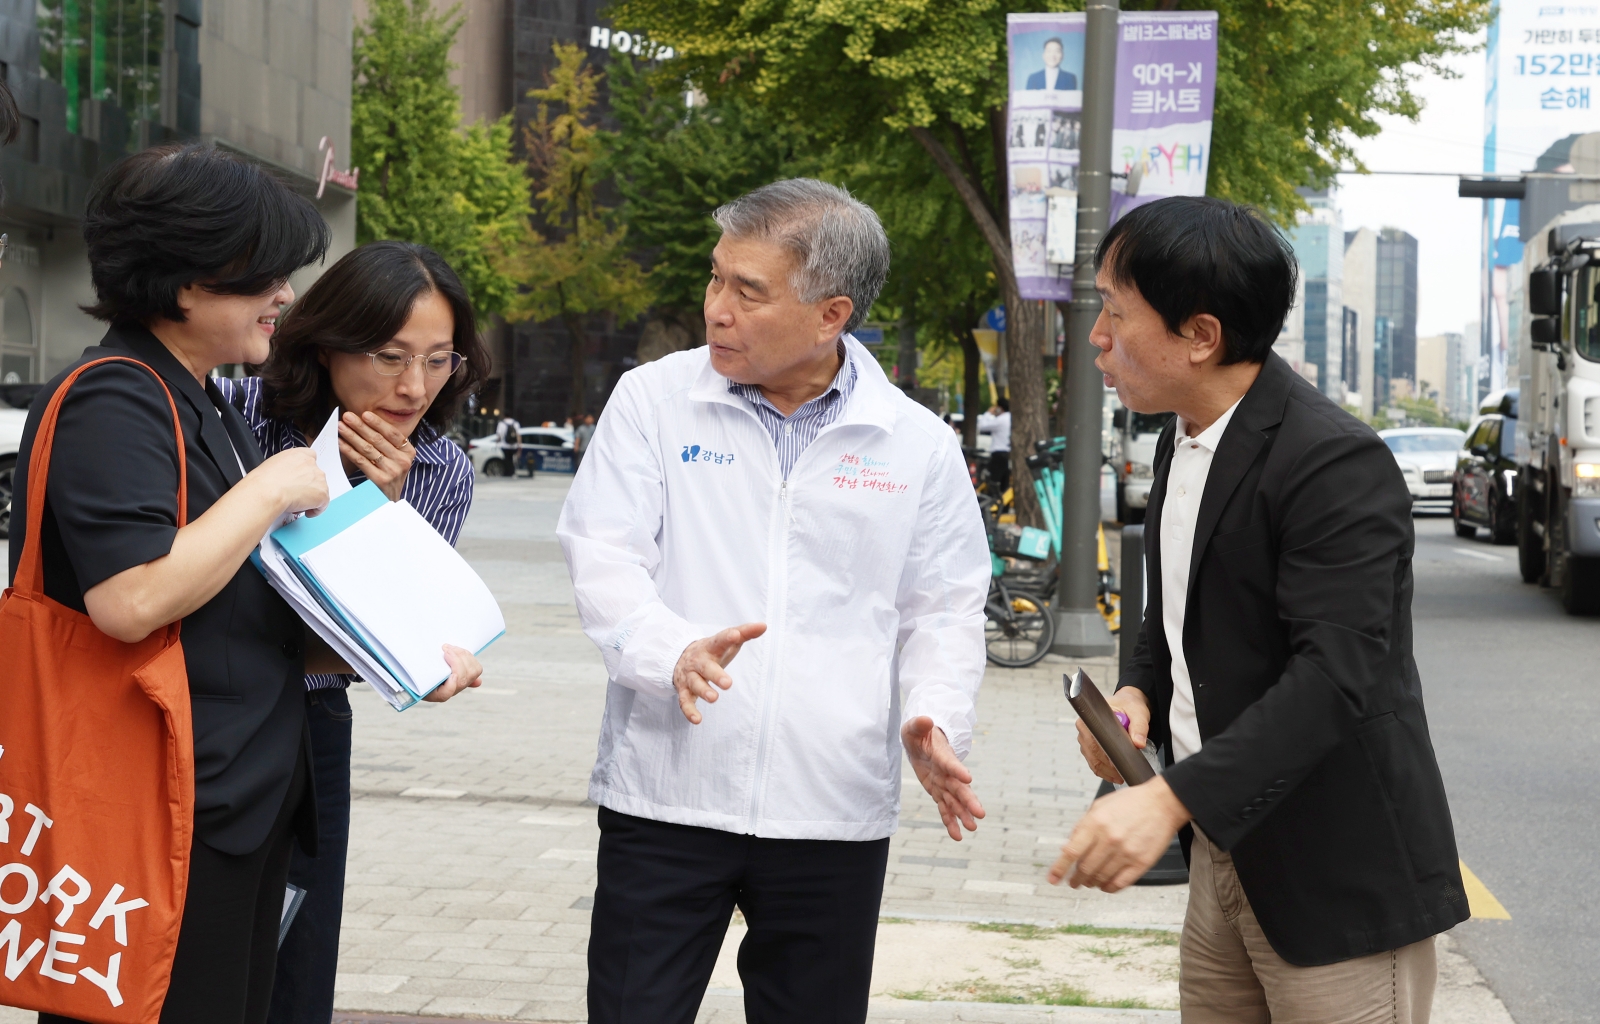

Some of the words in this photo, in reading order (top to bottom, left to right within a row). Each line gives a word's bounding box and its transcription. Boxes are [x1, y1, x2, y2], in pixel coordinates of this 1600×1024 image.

[1524, 29, 1573, 44] 가만히
[1516, 53, 1600, 76] 152만
[1541, 86, 1590, 110] 손해
[702, 450, 735, 465] 강남구
[833, 475, 860, 489] 강남
[862, 479, 908, 494] 대전환!!
